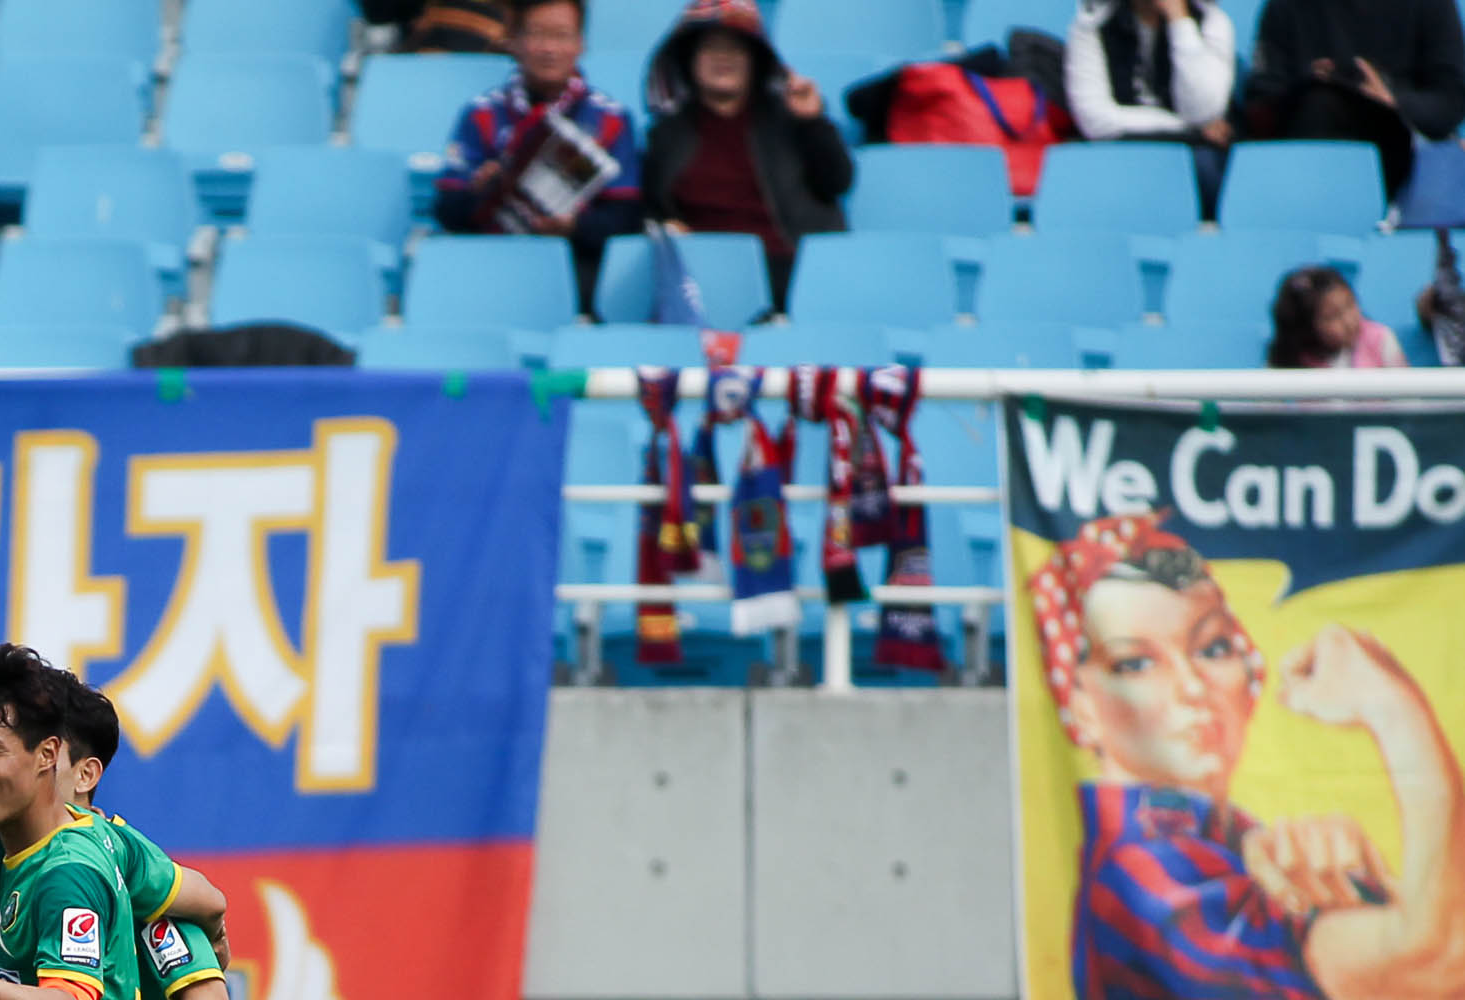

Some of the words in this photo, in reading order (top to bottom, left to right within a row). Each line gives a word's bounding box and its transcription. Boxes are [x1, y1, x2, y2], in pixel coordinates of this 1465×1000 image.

[1020, 408, 1159, 520] We
[1169, 426, 1335, 529] Can
[1352, 425, 1465, 529] Do
